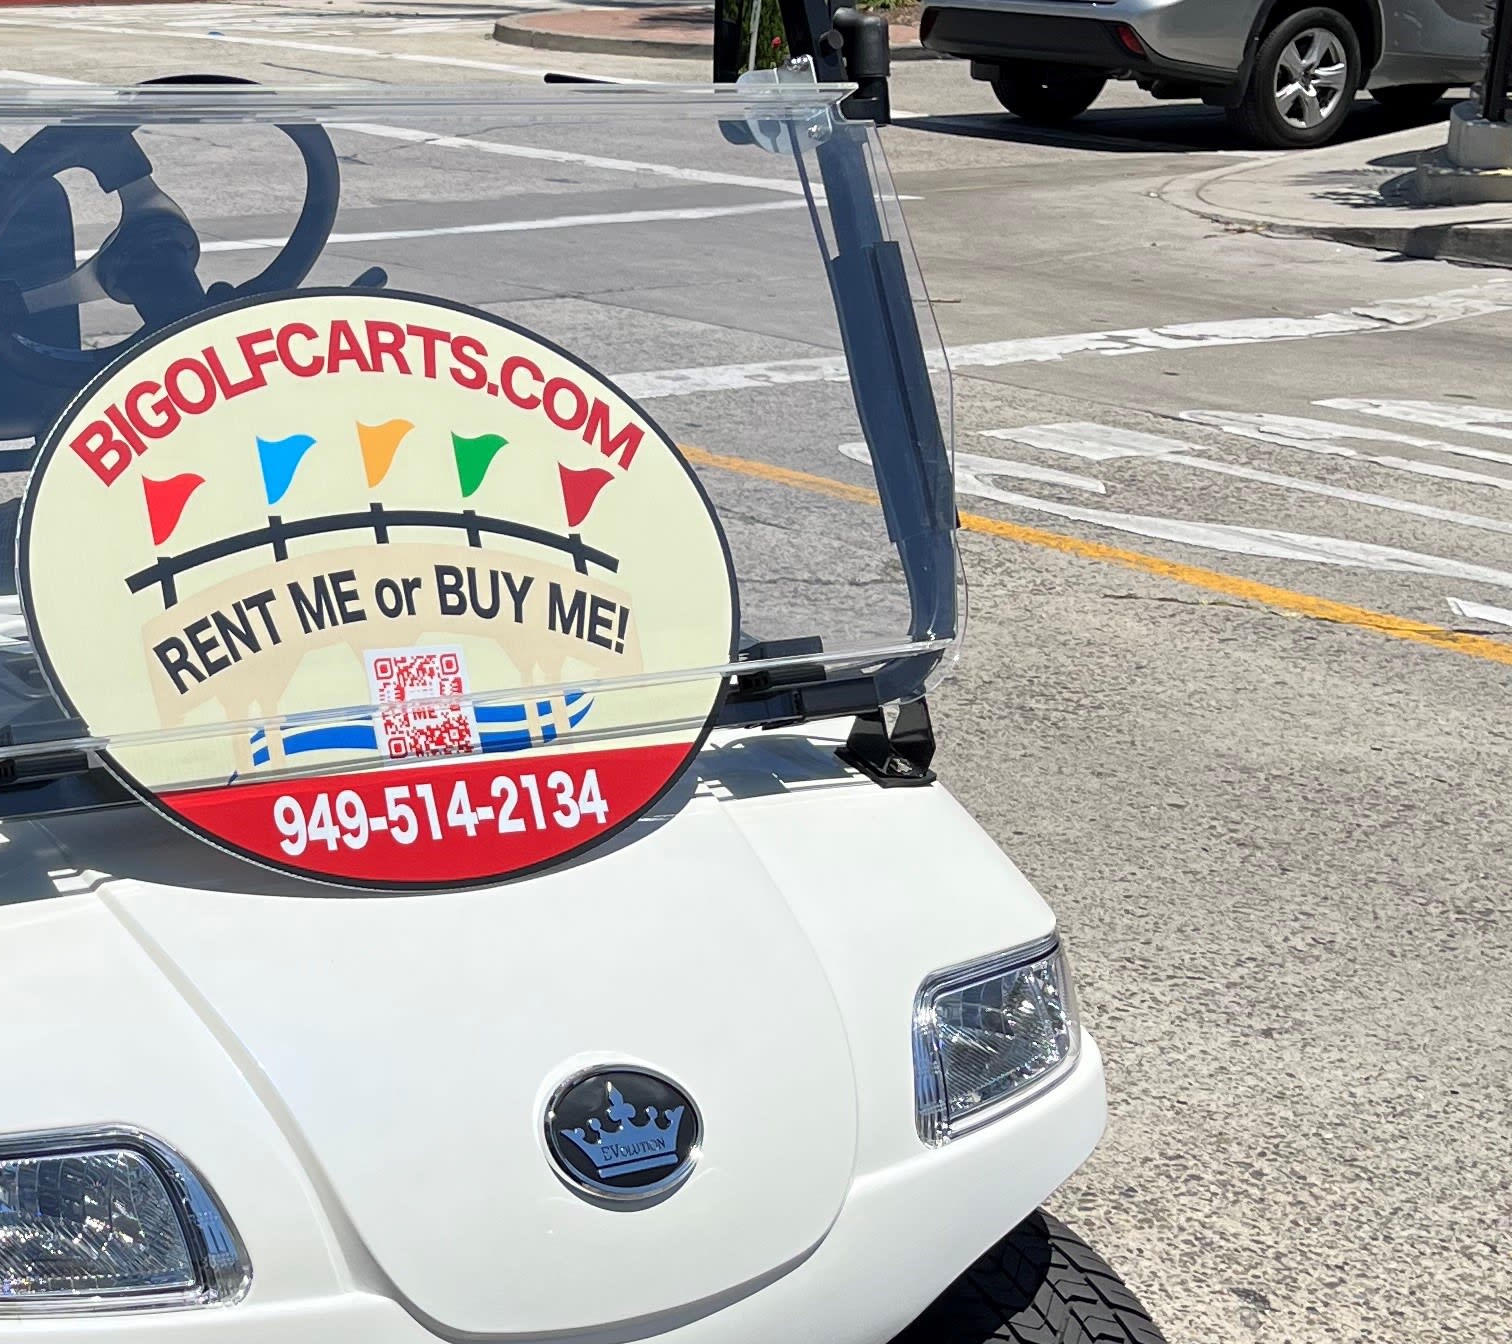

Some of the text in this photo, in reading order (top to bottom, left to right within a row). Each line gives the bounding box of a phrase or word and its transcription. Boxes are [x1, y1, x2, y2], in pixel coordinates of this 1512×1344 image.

[70, 319, 645, 487] BIGOLFCARTS.COM
[152, 564, 630, 695] RENT ME or BUY ME!
[273, 768, 609, 856] 949-514-2134
[601, 1137, 666, 1162] EVOLUTION
